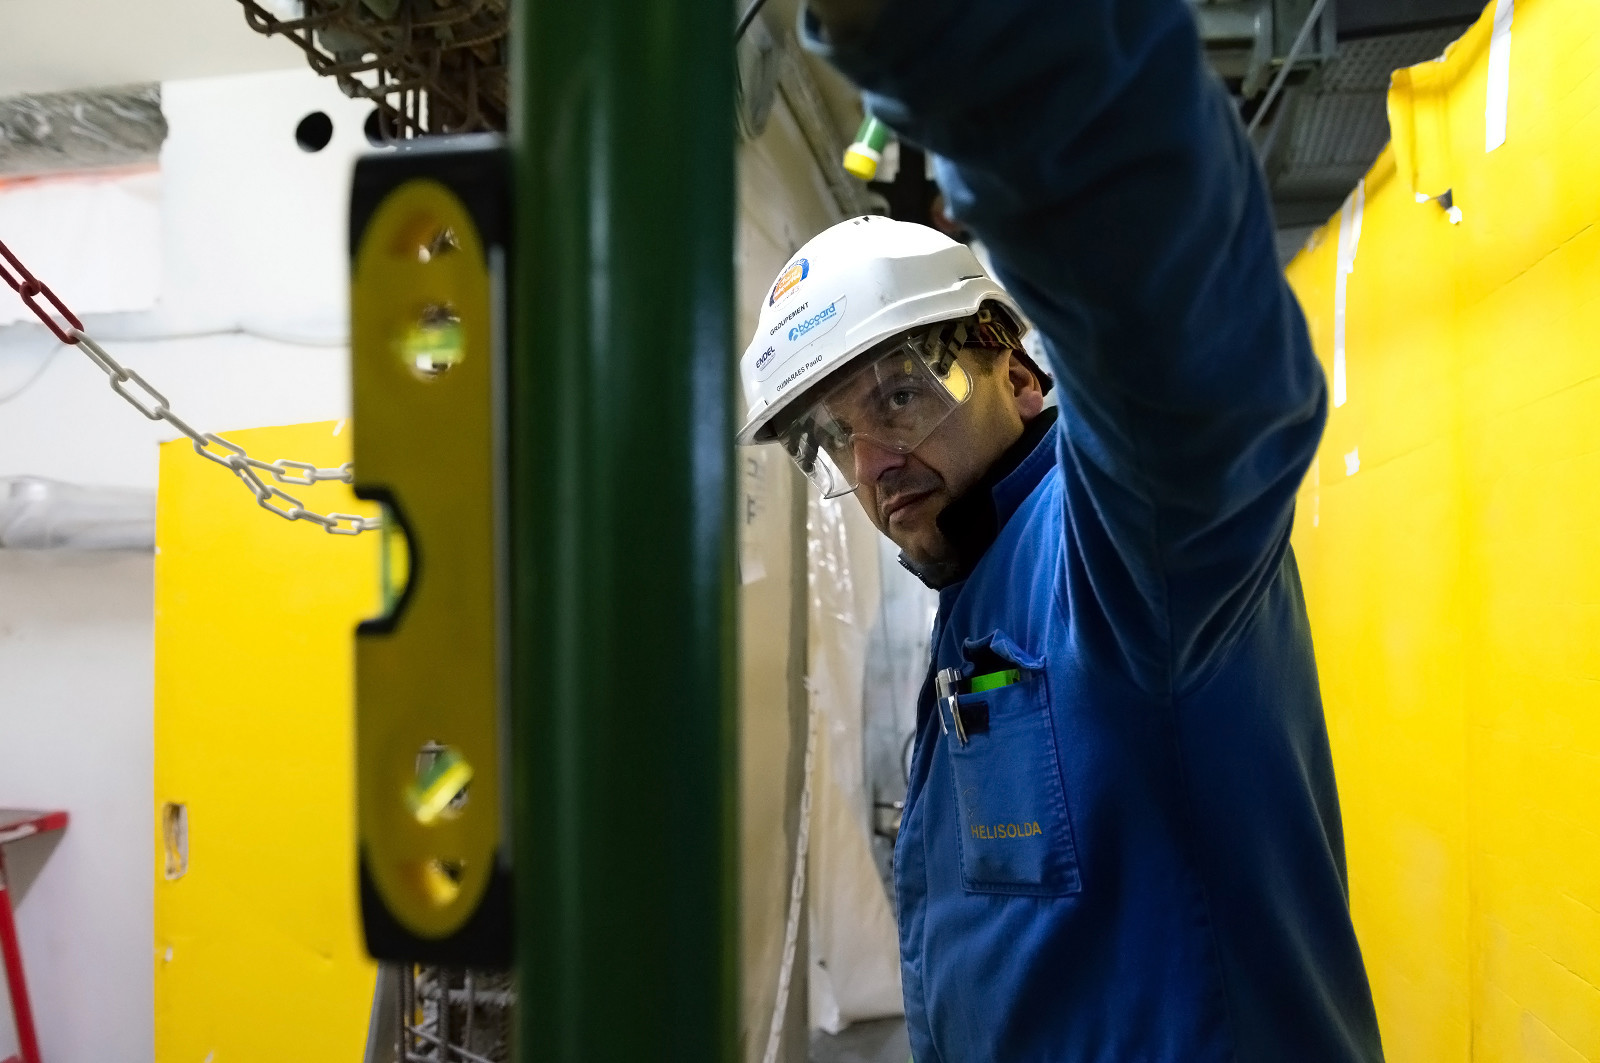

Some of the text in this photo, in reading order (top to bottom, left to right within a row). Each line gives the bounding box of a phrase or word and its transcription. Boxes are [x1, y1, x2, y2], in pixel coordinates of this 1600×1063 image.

[769, 301, 810, 336] GROUPEMENT
[755, 345, 776, 369] ENDEL
[970, 821, 1043, 839] HELISOLDA
